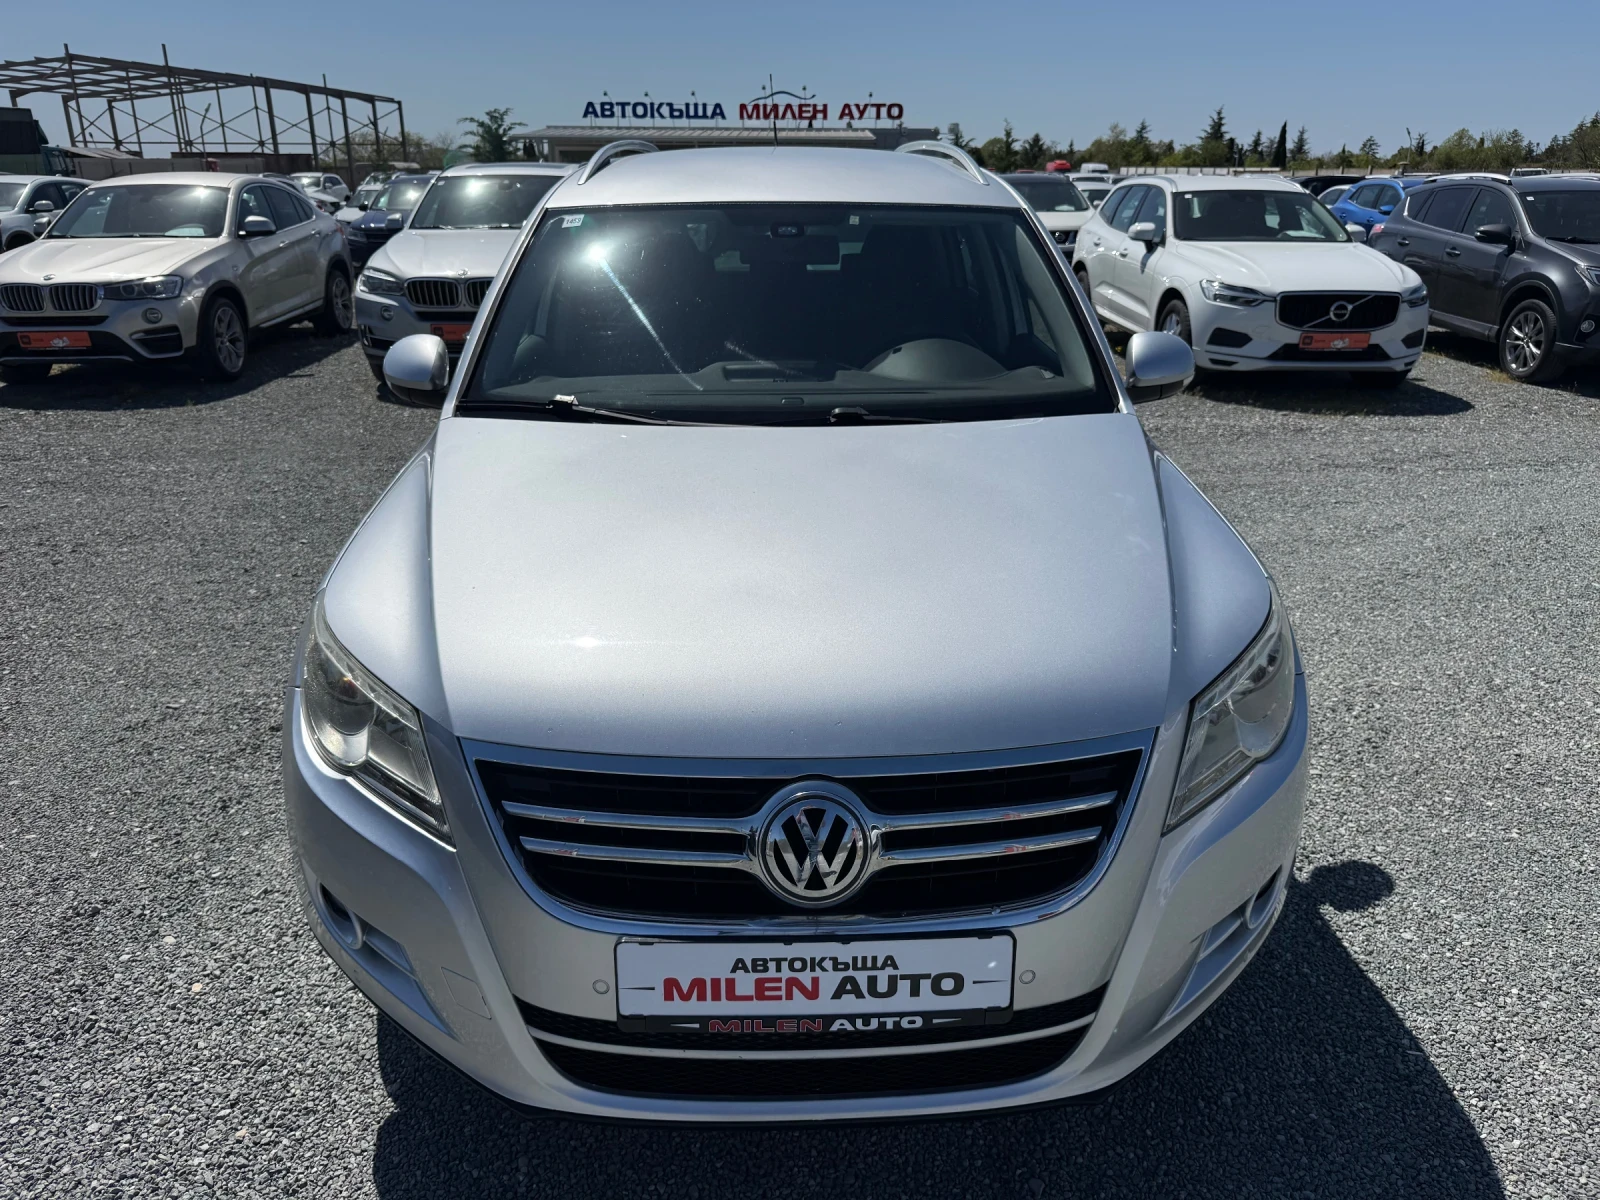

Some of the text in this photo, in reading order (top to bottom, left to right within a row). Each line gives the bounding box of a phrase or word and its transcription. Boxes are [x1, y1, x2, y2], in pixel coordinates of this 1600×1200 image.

[739, 103, 828, 120] МИЛЕН
[838, 103, 904, 120] АУТО
[663, 972, 965, 1002] MILEN AUTO
[708, 1015, 924, 1033] MILEN AUTO
